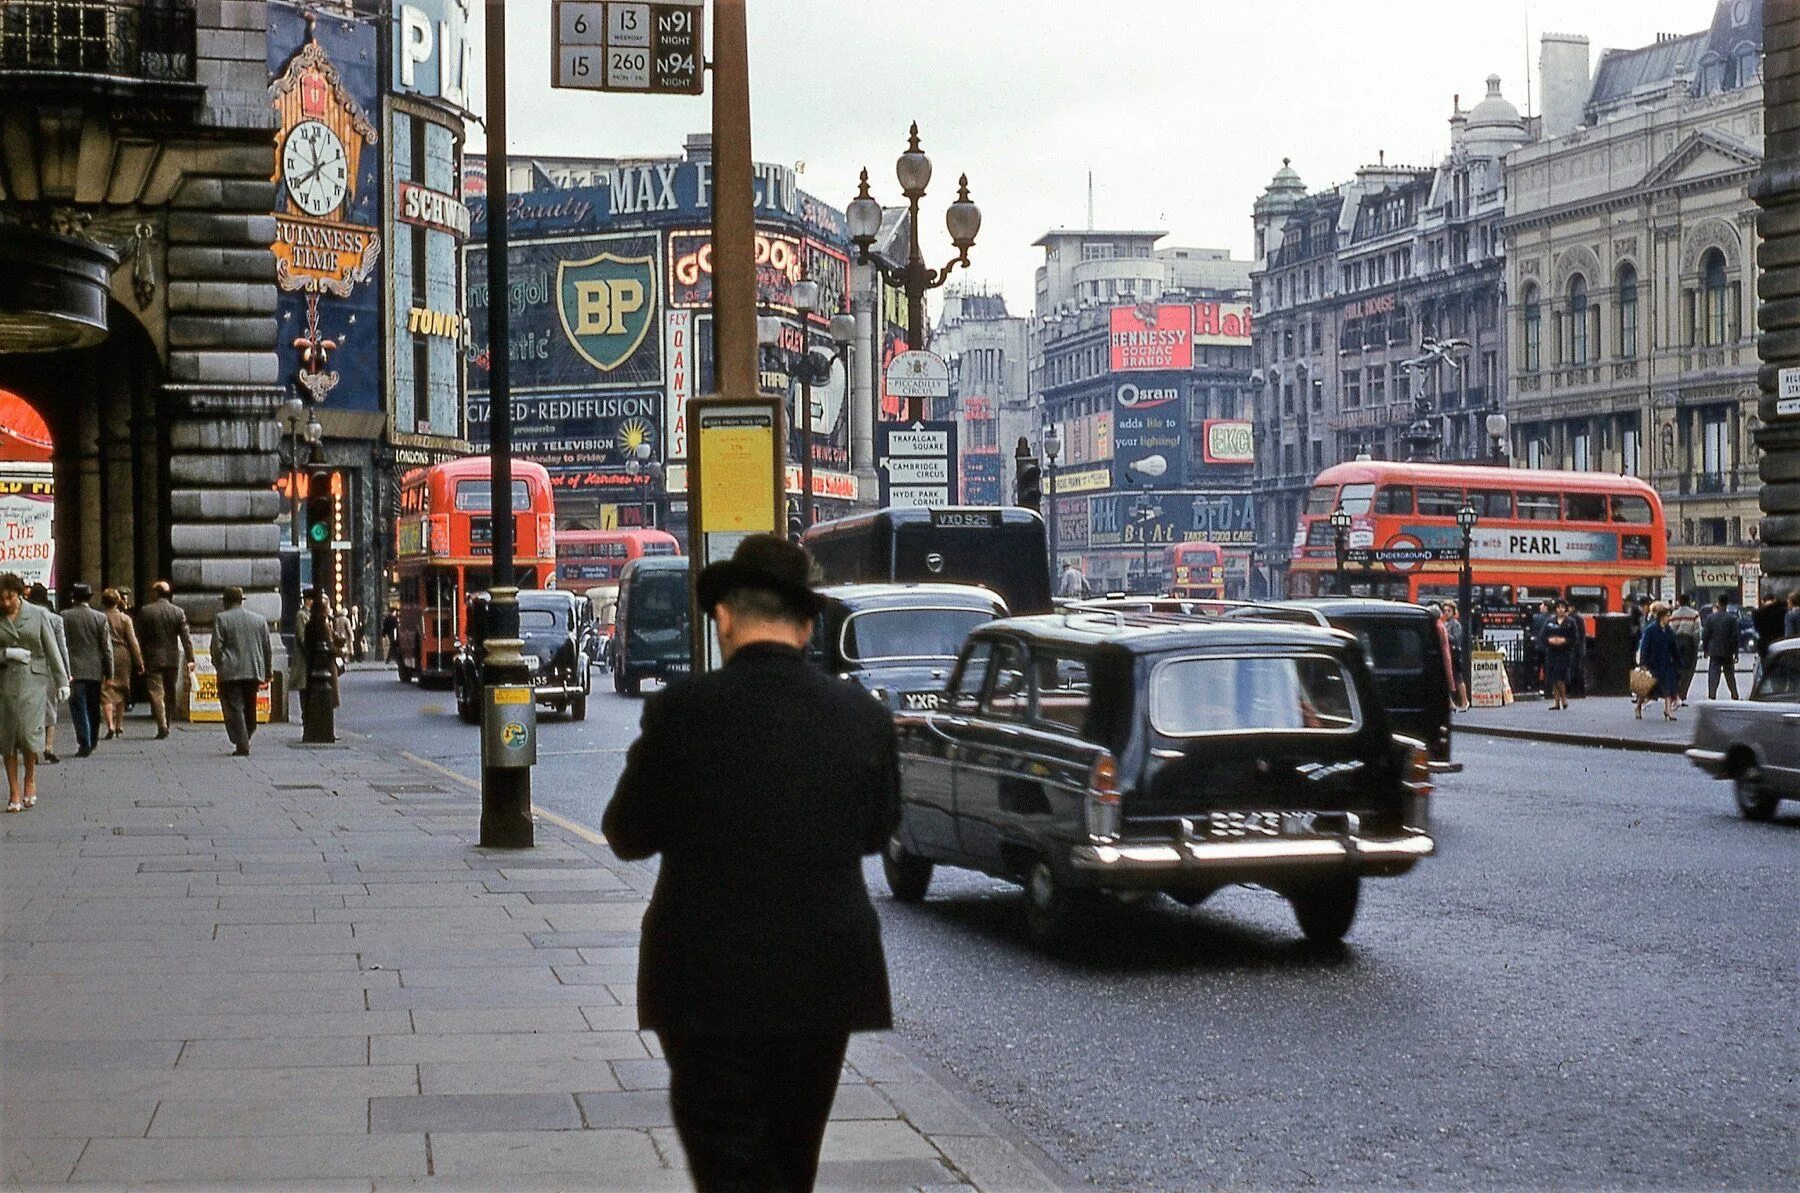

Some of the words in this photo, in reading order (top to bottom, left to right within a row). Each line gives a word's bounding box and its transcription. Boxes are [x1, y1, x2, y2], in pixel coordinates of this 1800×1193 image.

[574, 14, 587, 34] 6
[620, 10, 637, 30] 13
[659, 11, 692, 33] N91
[661, 36, 690, 45] NIGHT
[572, 56, 590, 76] 15
[613, 53, 645, 71] 260
[656, 53, 695, 75] N94
[661, 78, 691, 87] NIGHT
[608, 163, 680, 216] MAX
[293, 246, 338, 272] TIME
[573, 278, 644, 336] BP
[409, 307, 459, 339] TONIC
[669, 313, 687, 326] FLY
[1112, 329, 1186, 348] HENNESSY
[1122, 346, 1172, 356] COGNAC
[1122, 356, 1172, 367] BRANDY
[674, 331, 685, 454] QANTAS
[1117, 383, 1178, 408] Osram
[538, 397, 653, 420] REDIFFUSION
[1119, 418, 1143, 429] adds
[1166, 418, 1176, 428] to
[543, 439, 614, 452] TELEVISION
[1115, 437, 1138, 449] your
[1212, 428, 1253, 455] EKC
[563, 453, 575, 462] to
[576, 452, 607, 463] Friday
[567, 474, 581, 489] of
[7, 523, 34, 540] THE
[1509, 535, 1561, 554] PEARL
[1376, 550, 1432, 560] UNDERGROUND
[906, 694, 939, 709] YXR
